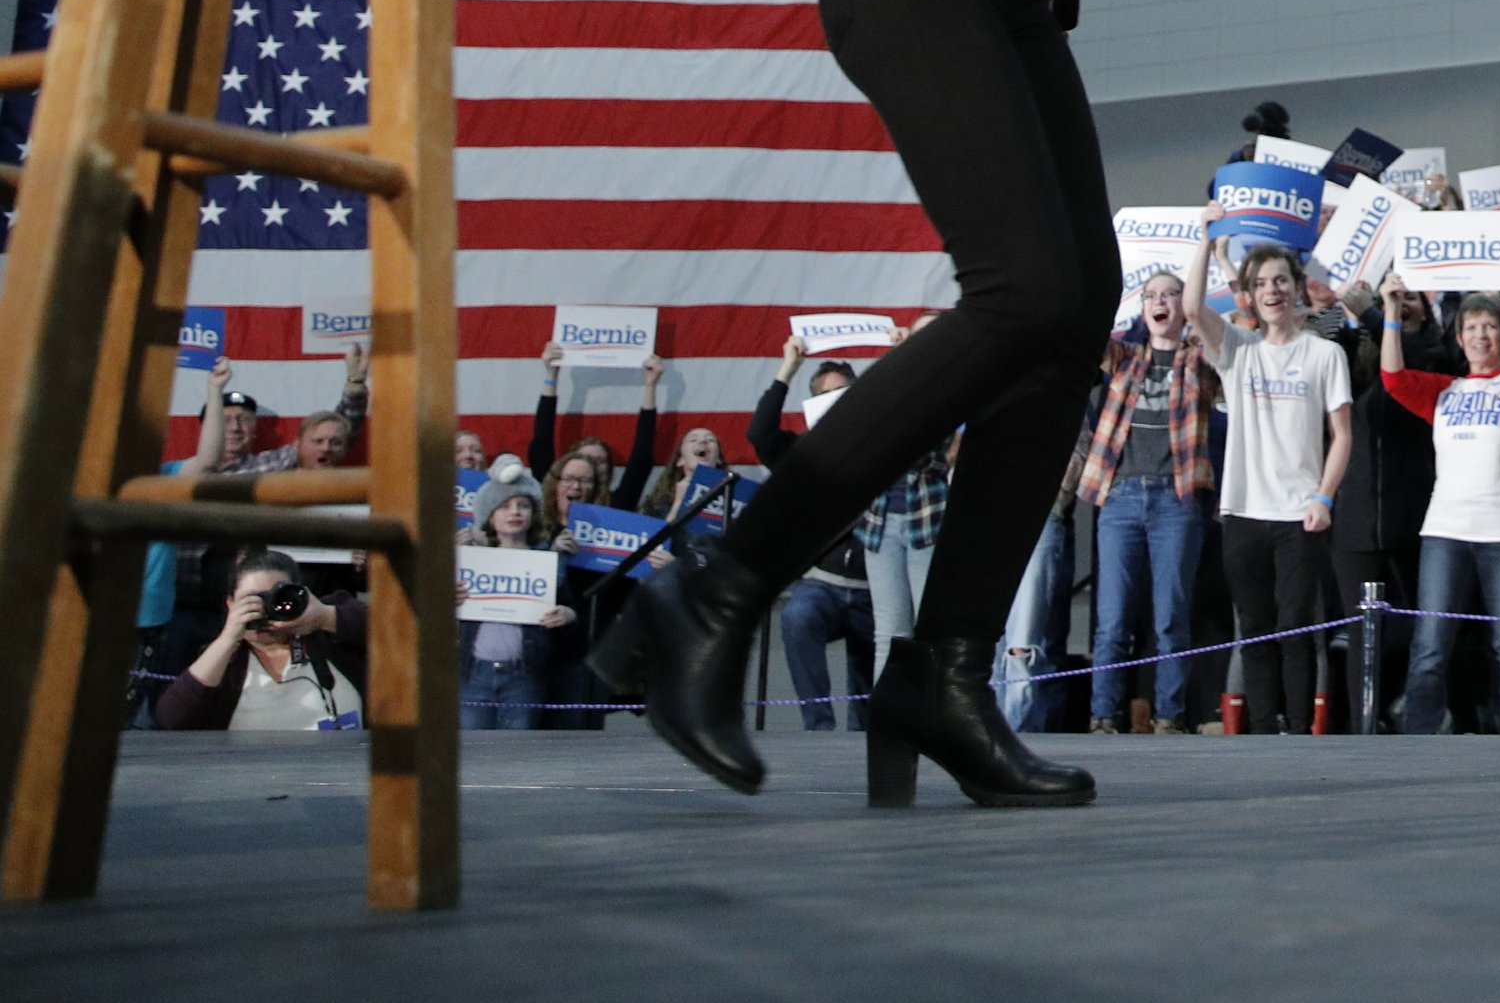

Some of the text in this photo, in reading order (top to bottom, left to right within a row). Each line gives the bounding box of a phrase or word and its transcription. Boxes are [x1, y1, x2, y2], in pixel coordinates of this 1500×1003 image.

[1217, 185, 1314, 221] Bernie
[1118, 219, 1203, 241] Bernie
[1327, 195, 1391, 284] Bernie
[311, 312, 371, 332] Ber
[802, 322, 890, 338] Bernie
[178, 323, 219, 348] nie
[561, 323, 646, 346] Bernie
[1243, 376, 1309, 396] ernie
[574, 519, 650, 554] Berni
[459, 567, 547, 597] Bernie
